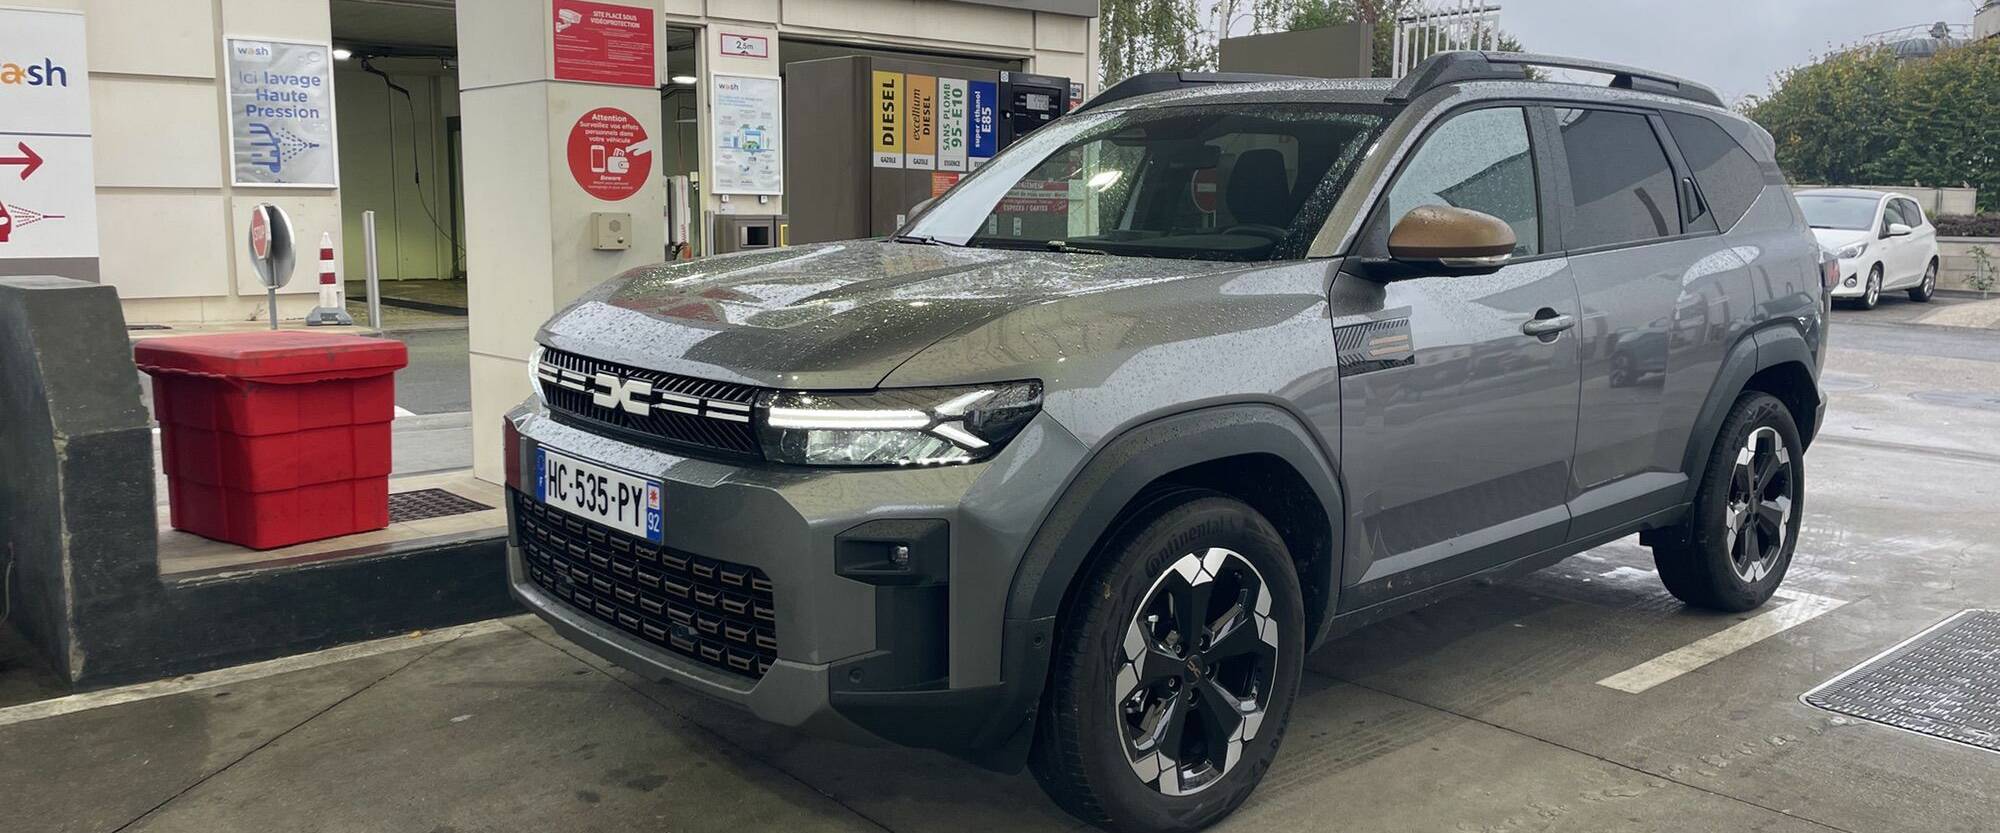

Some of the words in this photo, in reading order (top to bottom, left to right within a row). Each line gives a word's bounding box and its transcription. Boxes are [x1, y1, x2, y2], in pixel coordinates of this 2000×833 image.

[237, 44, 269, 57] wash
[239, 69, 258, 84] Ici
[264, 70, 321, 89] lavage
[256, 88, 309, 104] Haute
[943, 83, 951, 120] PLOMB
[246, 104, 320, 119] Pression
[592, 113, 627, 122] Attention
[882, 78, 895, 147] DIESEL
[913, 88, 921, 141] excellium
[923, 95, 931, 136] DIESEL
[951, 87, 963, 148] 95-E10
[982, 106, 992, 133] E85
[579, 121, 609, 129] Surveillez
[622, 123, 639, 131] effets
[943, 124, 951, 151] SANS
[974, 123, 982, 148] super
[880, 156, 896, 164] GAZOLE
[548, 459, 642, 527] HC-535-PY
[648, 512, 660, 532] 92
[1145, 516, 1224, 578] Continental
